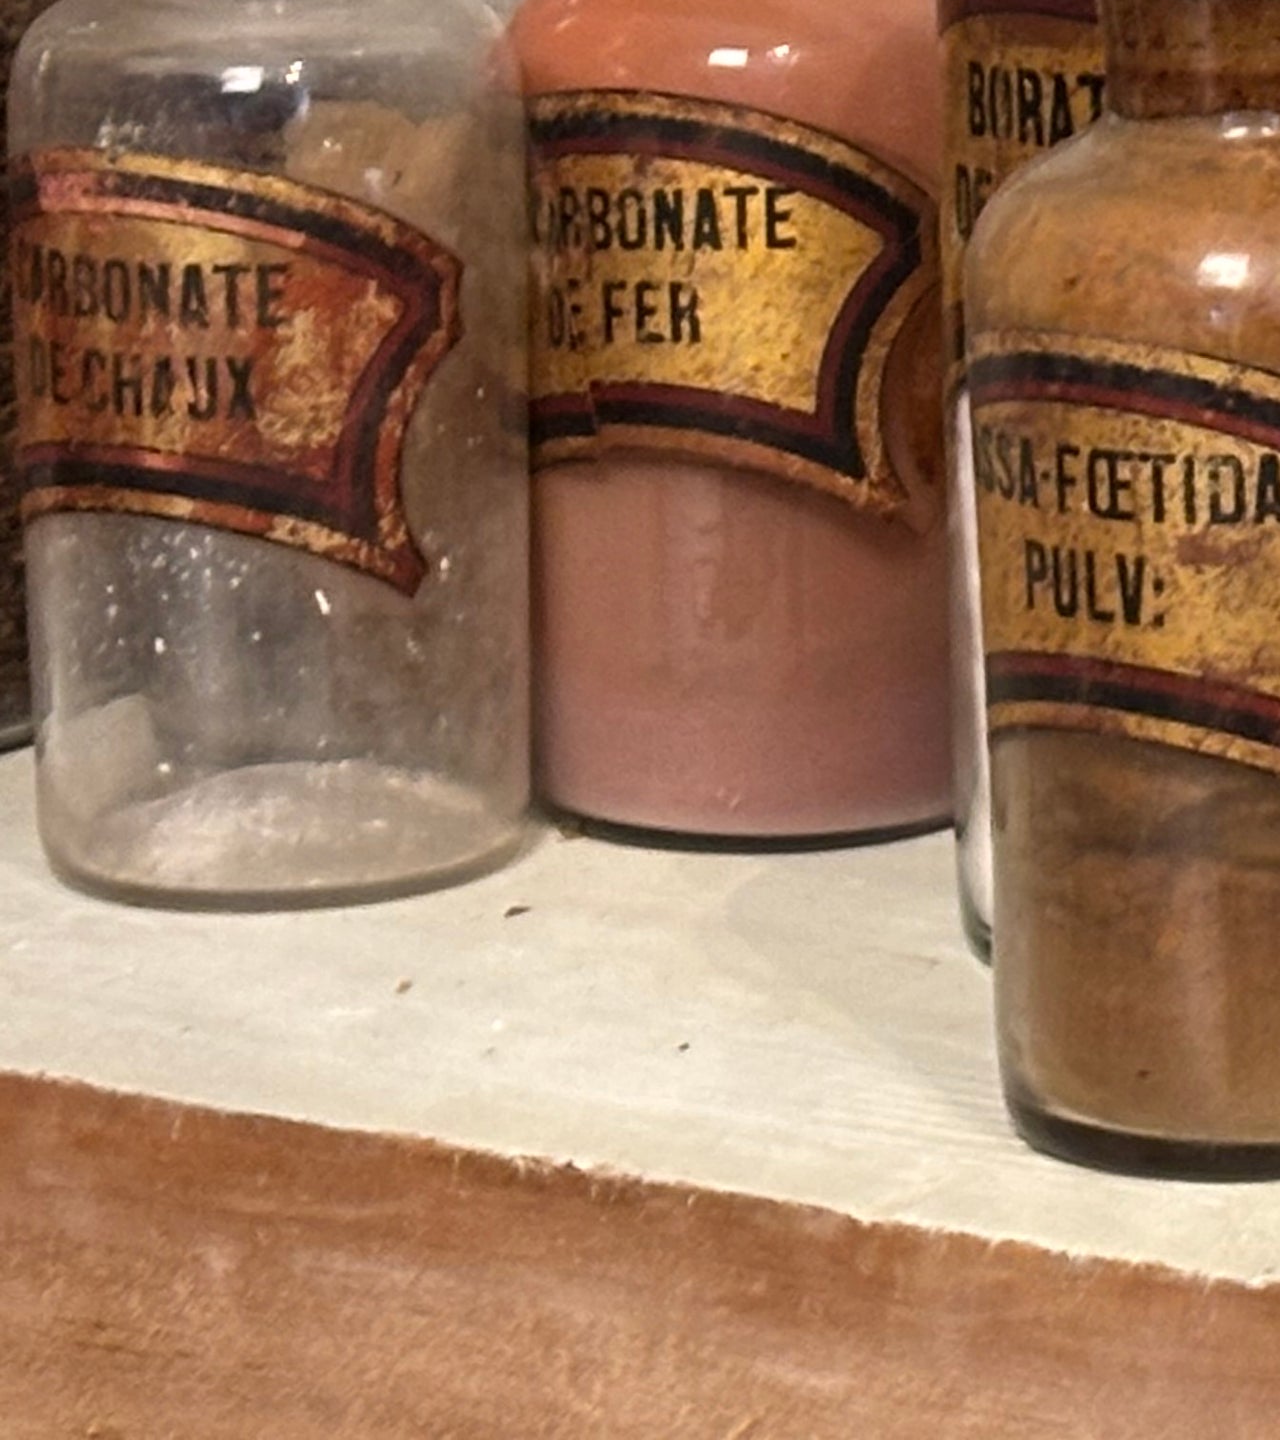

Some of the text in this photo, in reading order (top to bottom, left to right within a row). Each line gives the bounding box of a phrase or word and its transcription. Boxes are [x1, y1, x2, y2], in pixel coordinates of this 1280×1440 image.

[967, 61, 1106, 149] BORAT
[602, 279, 702, 344] FER
[28, 333, 258, 422] DE CHAUX
[1024, 538, 1166, 627] PULV:
